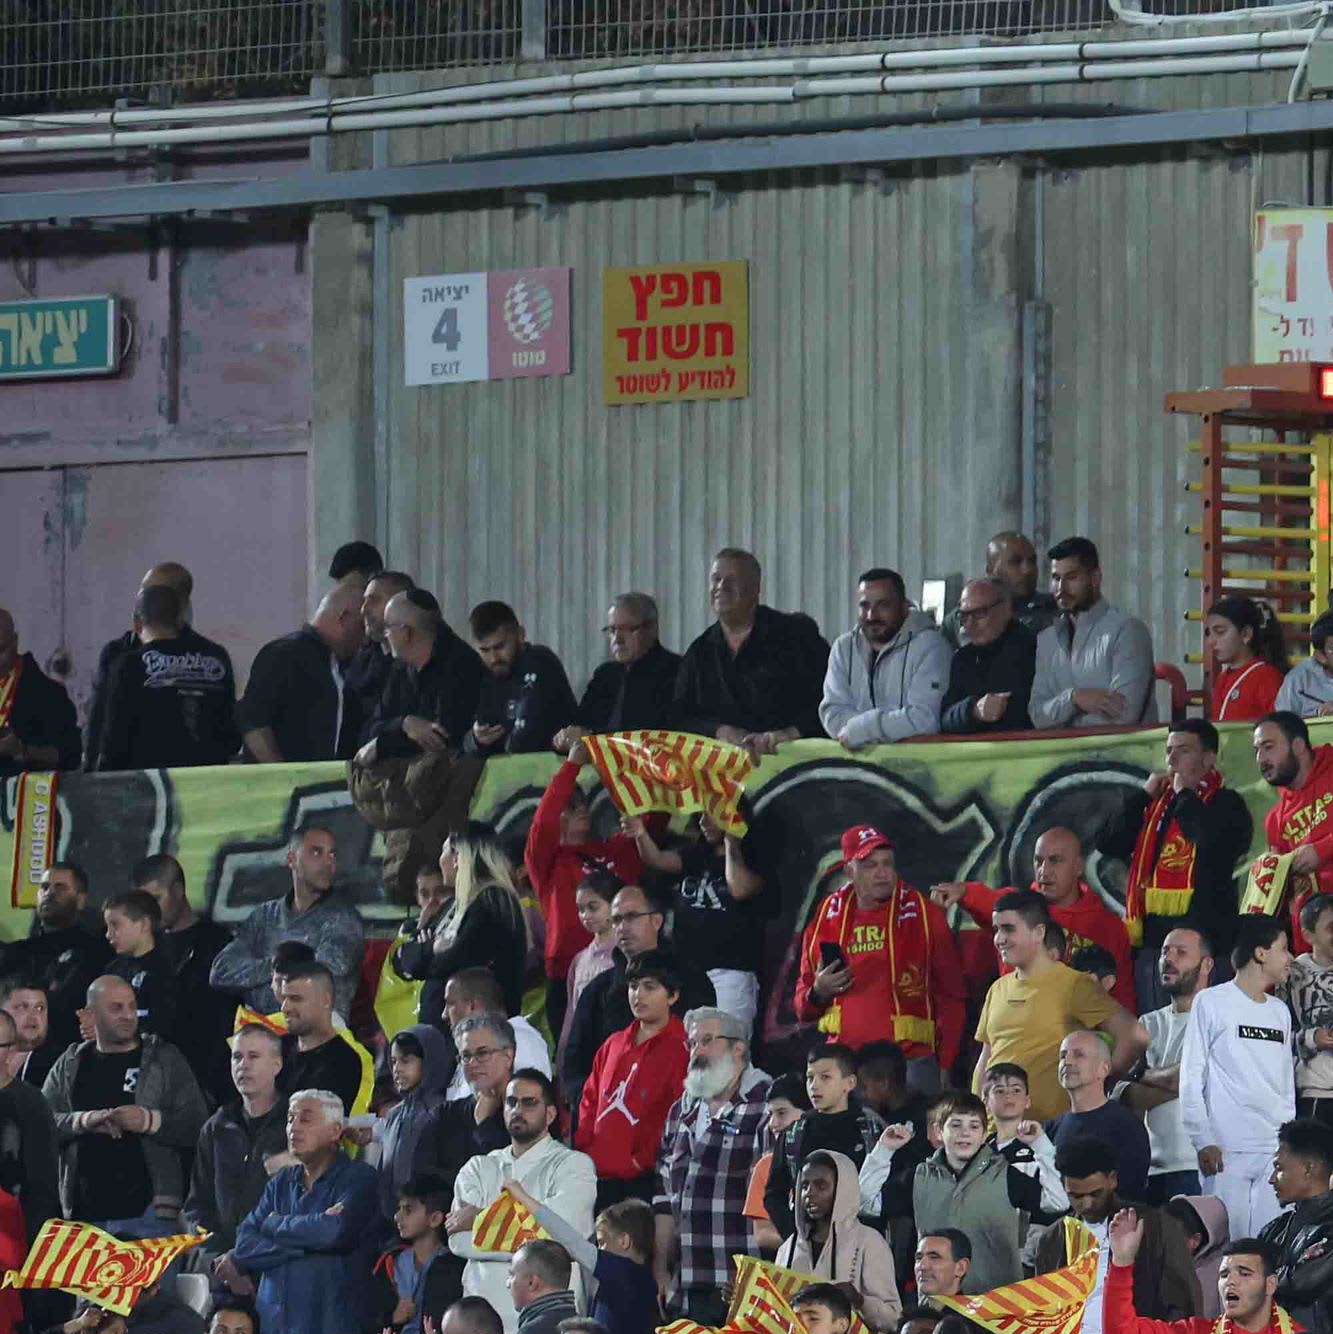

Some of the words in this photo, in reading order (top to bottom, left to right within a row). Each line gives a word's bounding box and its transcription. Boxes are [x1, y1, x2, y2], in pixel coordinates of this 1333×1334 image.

[422, 284, 470, 303] יציאה
[628, 269, 722, 322] חפץ
[431, 308, 462, 353] 4
[616, 321, 736, 363] חשוד
[431, 360, 462, 377] EXIT
[615, 368, 672, 394] לשוטר
[676, 365, 736, 393] להודיע
